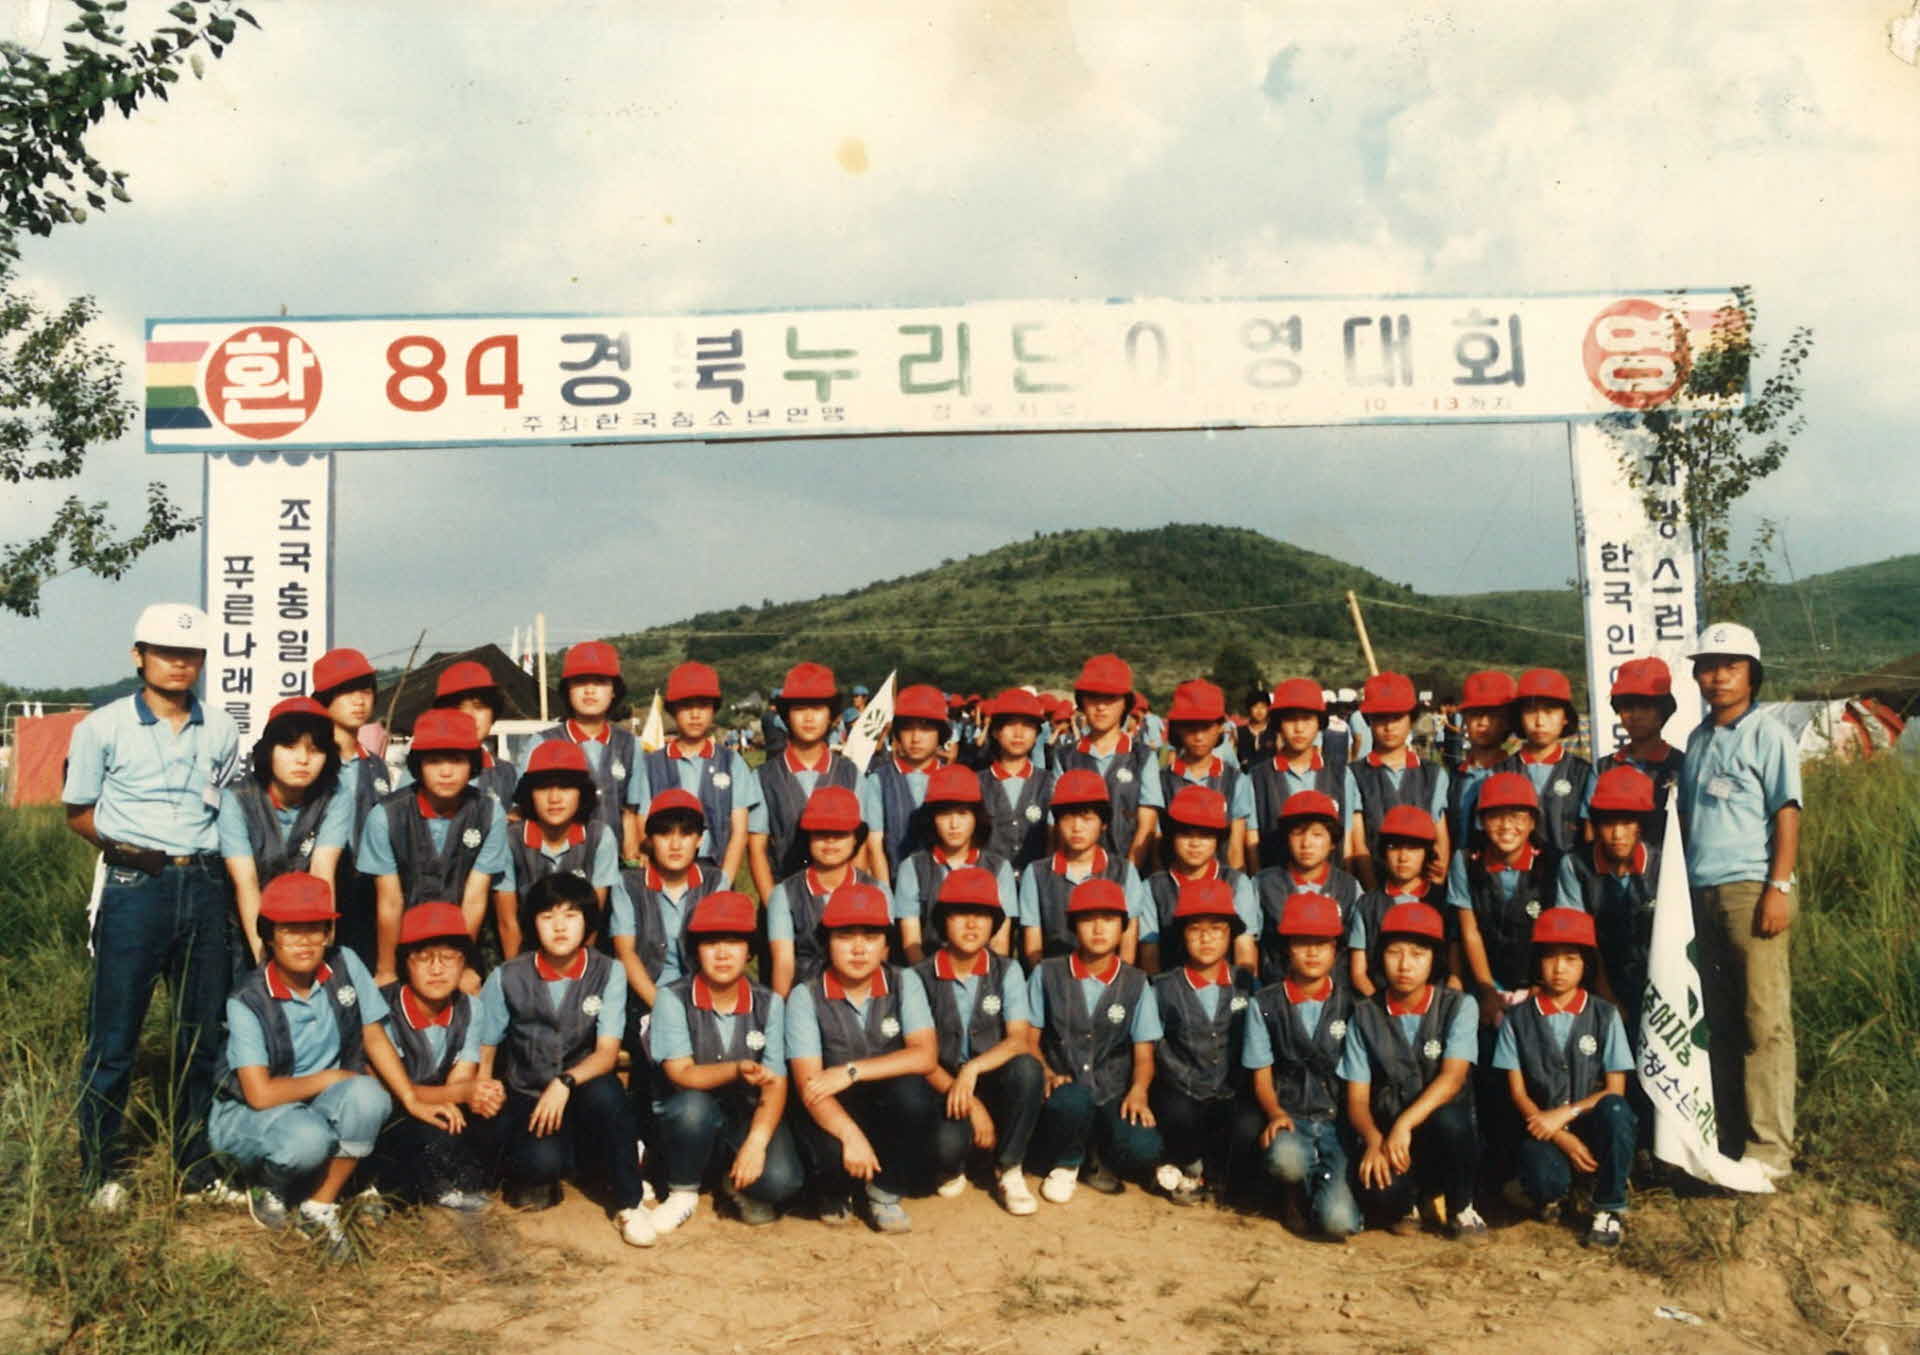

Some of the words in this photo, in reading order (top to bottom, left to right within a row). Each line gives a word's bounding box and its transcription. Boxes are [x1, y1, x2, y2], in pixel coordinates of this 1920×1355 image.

[221, 332, 314, 425] 환
[385, 334, 524, 412] 84
[1601, 542, 1635, 684] 한국인
